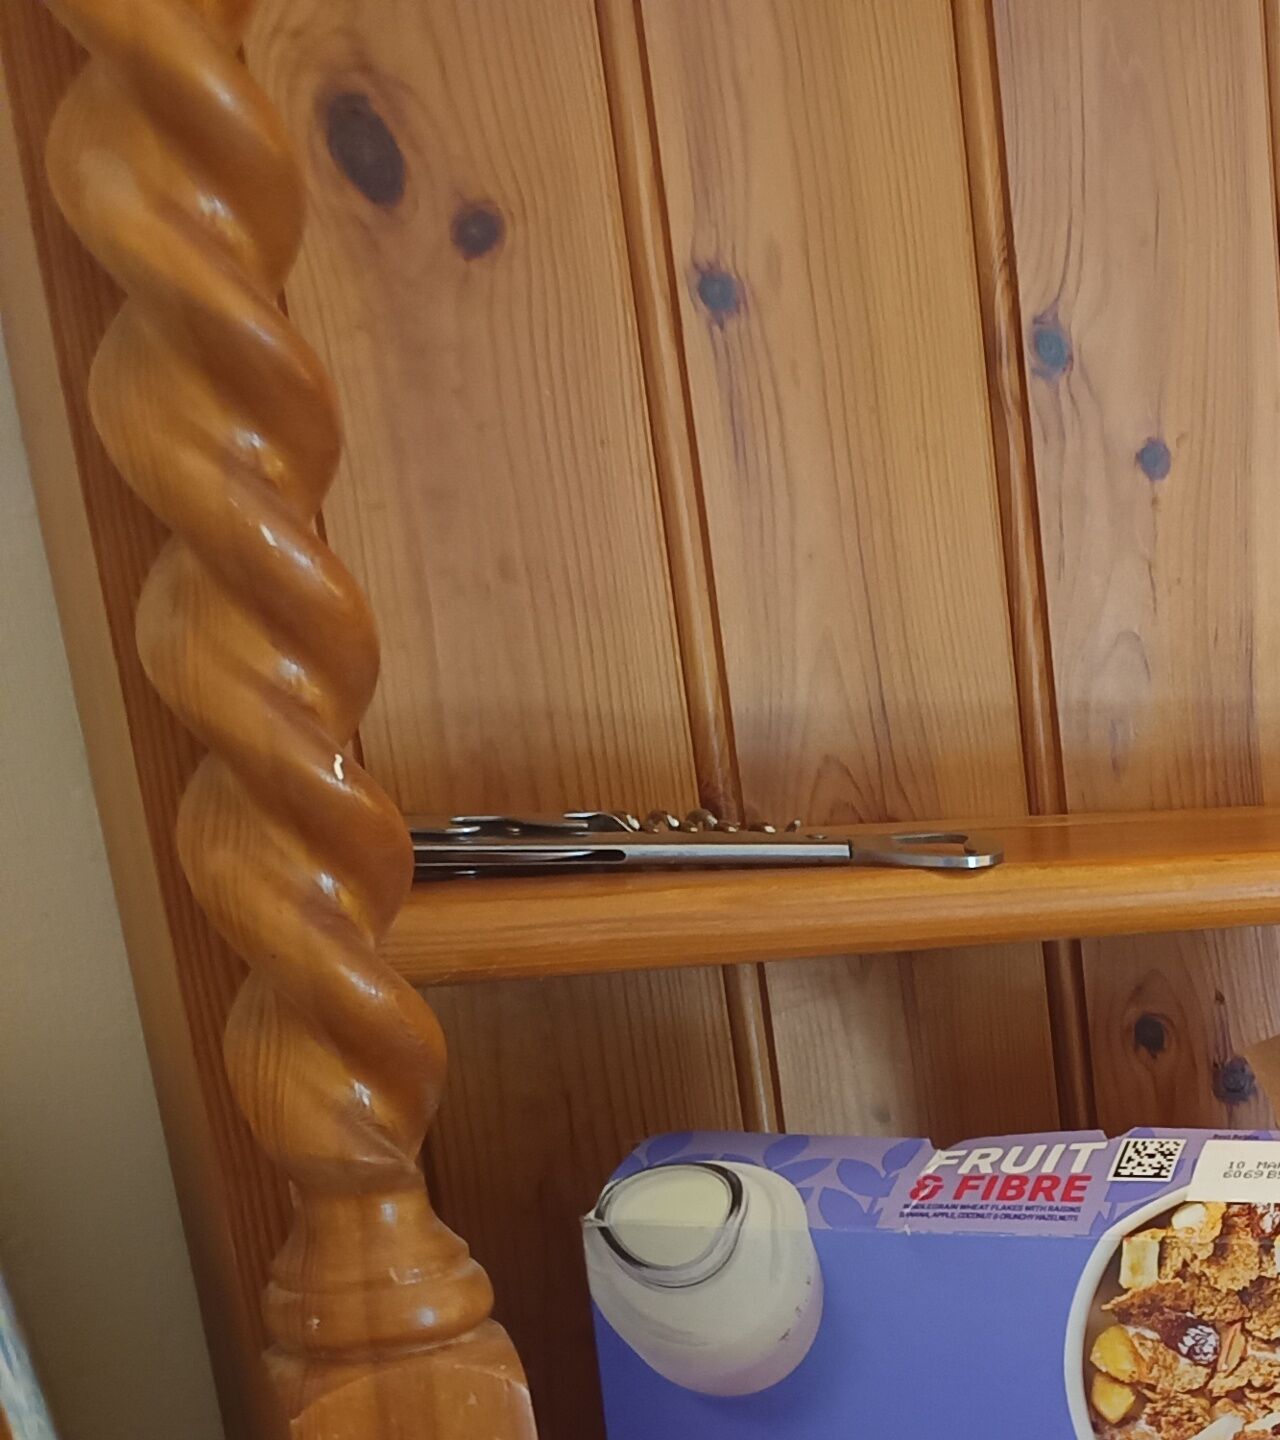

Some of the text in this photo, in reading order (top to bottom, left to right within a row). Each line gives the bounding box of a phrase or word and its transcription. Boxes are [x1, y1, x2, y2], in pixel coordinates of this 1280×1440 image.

[918, 1141, 1108, 1176] FRUIT
[1228, 1161, 1245, 1170] 10
[1223, 1170, 1263, 1179] 6069
[910, 1174, 1092, 1203] & FIBRE
